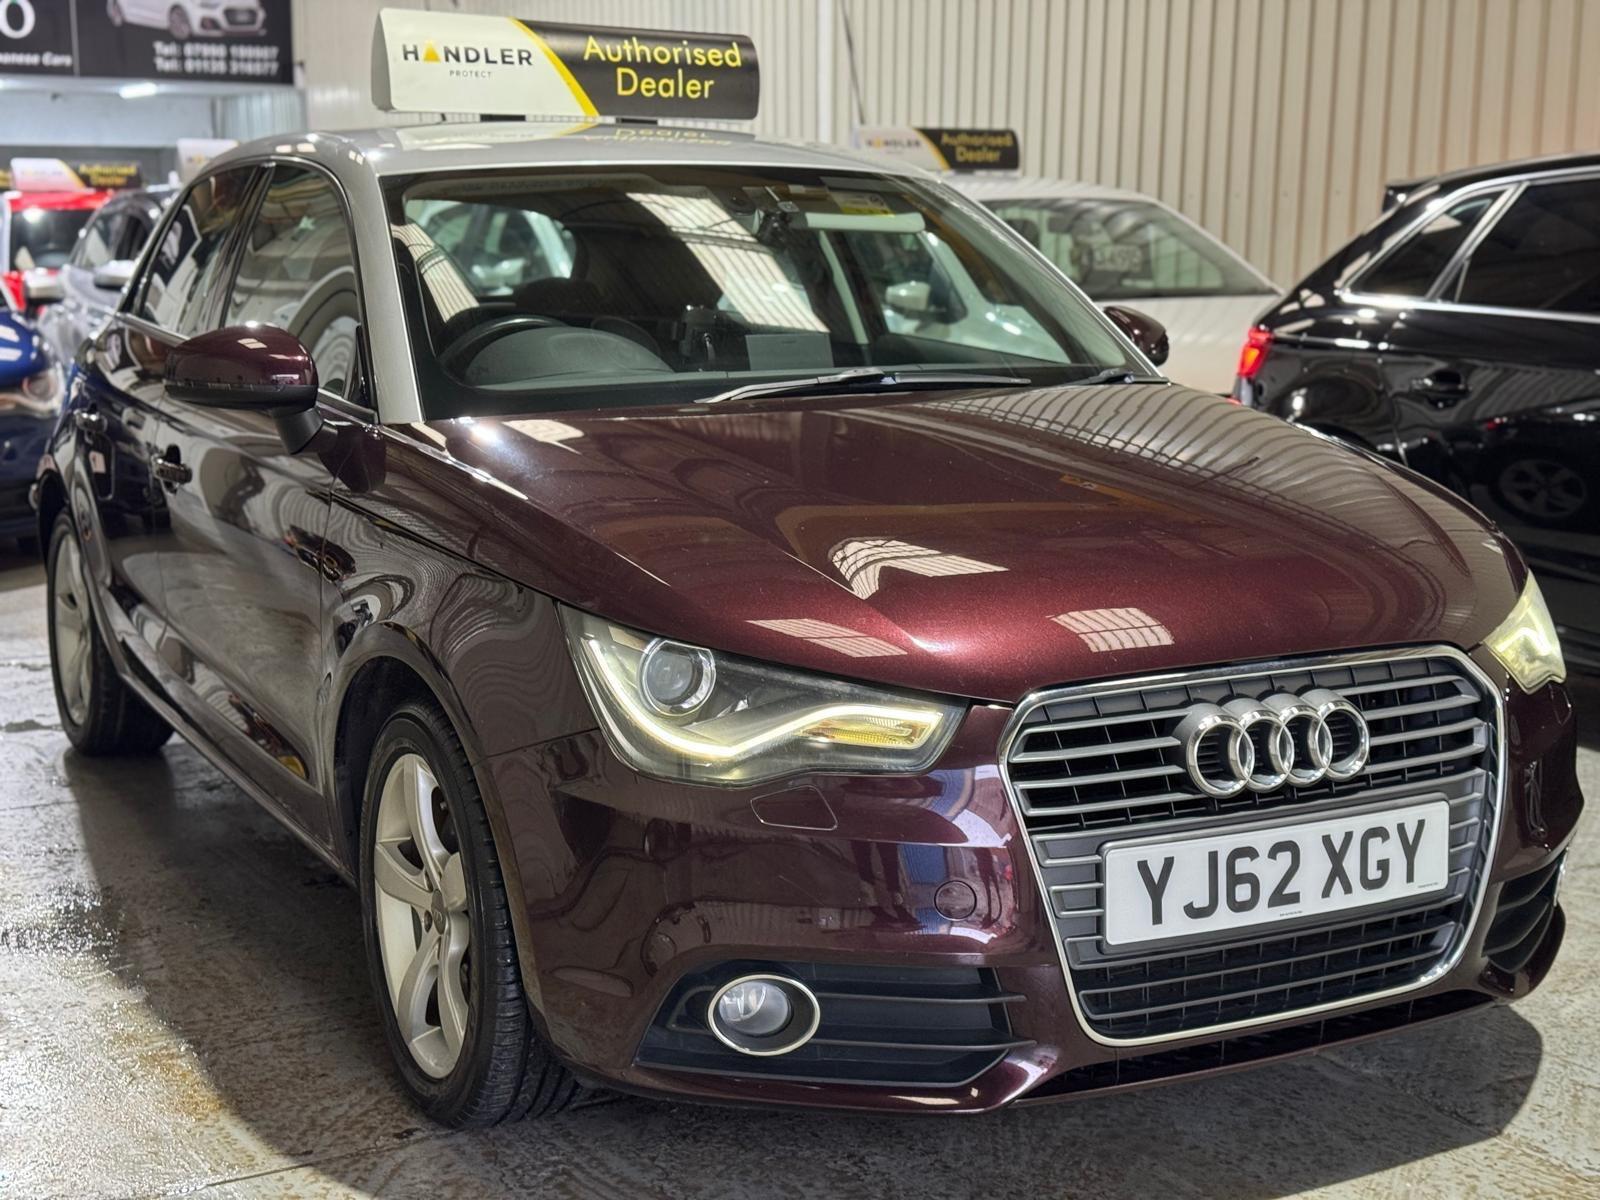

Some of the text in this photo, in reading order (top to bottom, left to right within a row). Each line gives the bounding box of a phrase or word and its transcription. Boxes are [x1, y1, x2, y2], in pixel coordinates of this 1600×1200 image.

[402, 41, 533, 65] HANDLER
[583, 35, 742, 67] Authorised
[449, 69, 493, 78] PROTECT
[616, 67, 715, 99] Dealer
[1137, 819, 1426, 926] YJ62 XGY
